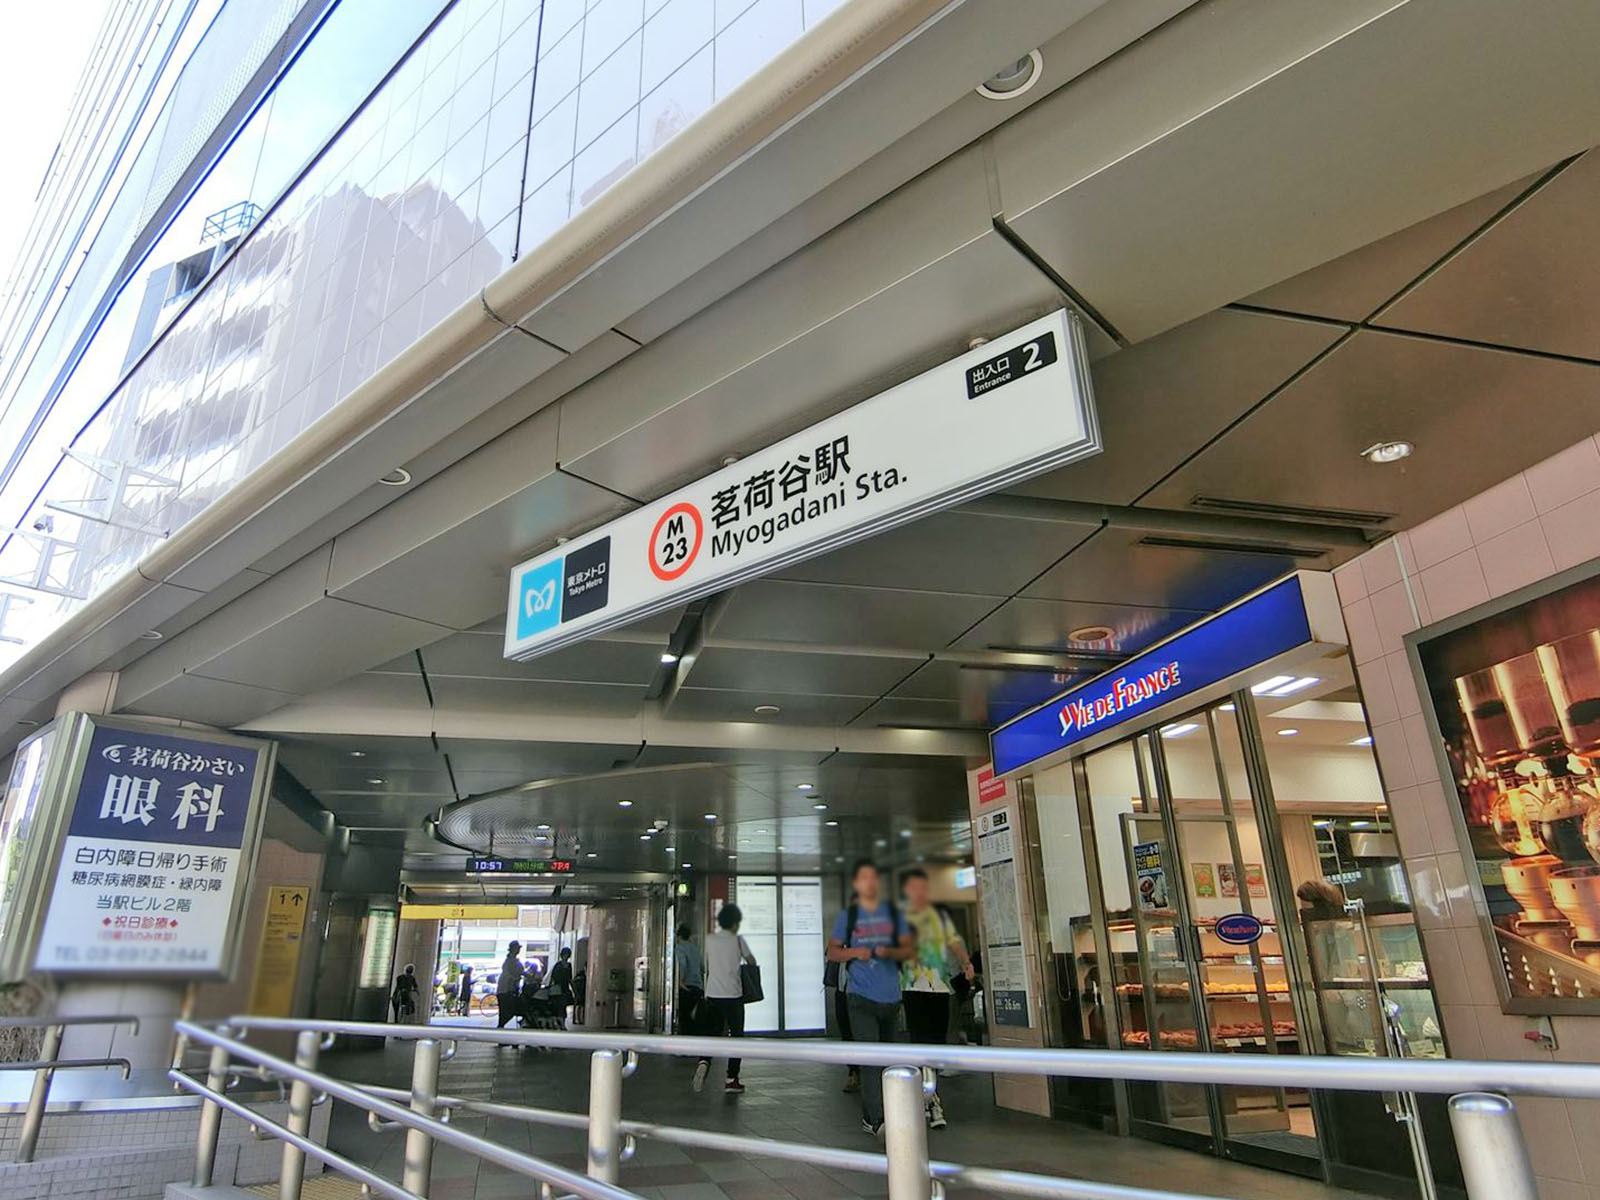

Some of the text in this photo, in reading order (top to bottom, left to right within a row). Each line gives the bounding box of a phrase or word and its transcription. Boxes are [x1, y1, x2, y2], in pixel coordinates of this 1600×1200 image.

[972, 356, 1010, 384] 出入口
[1022, 342, 1043, 372] 2
[974, 372, 1012, 394] Entrance
[711, 434, 852, 529] 茗荷谷駅
[711, 466, 908, 557] Myogadani Sta.
[667, 515, 684, 539] M
[663, 537, 688, 566] 23
[567, 562, 606, 588] 東京メトロ
[569, 577, 603, 597] Tokyo Metro
[128, 746, 245, 776] 茗荷谷かさい
[75, 846, 228, 873] 白内障日帰り手術
[474, 861, 502, 872] 10:57
[96, 895, 192, 912] 当駅ビル2階
[280, 894, 286, 905] 1
